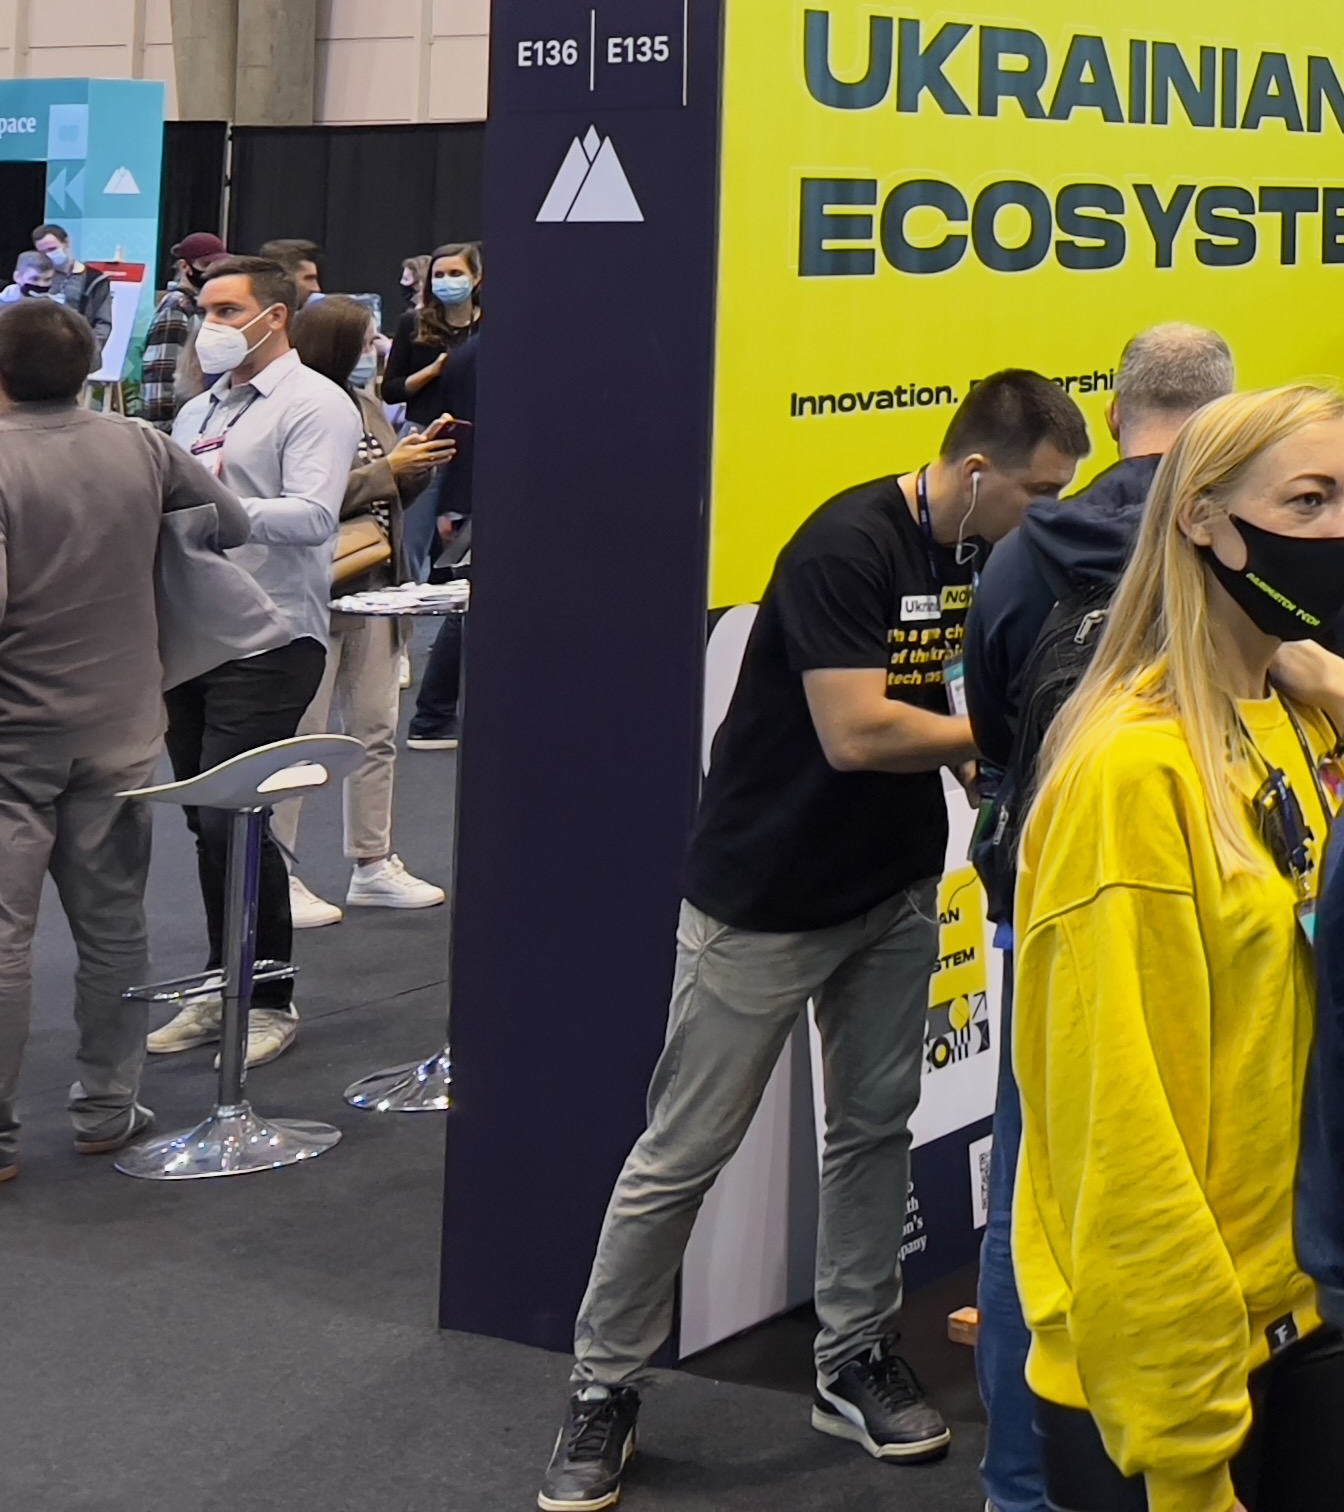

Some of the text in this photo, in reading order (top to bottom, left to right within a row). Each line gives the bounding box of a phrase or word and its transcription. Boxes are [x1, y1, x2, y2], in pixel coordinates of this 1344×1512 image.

[518, 39, 578, 67] E136
[607, 35, 670, 63] E135
[0, 115, 37, 140] pace
[789, 383, 958, 417] Innovation.
[945, 588, 973, 605] NO
[932, 945, 976, 974] STEM
